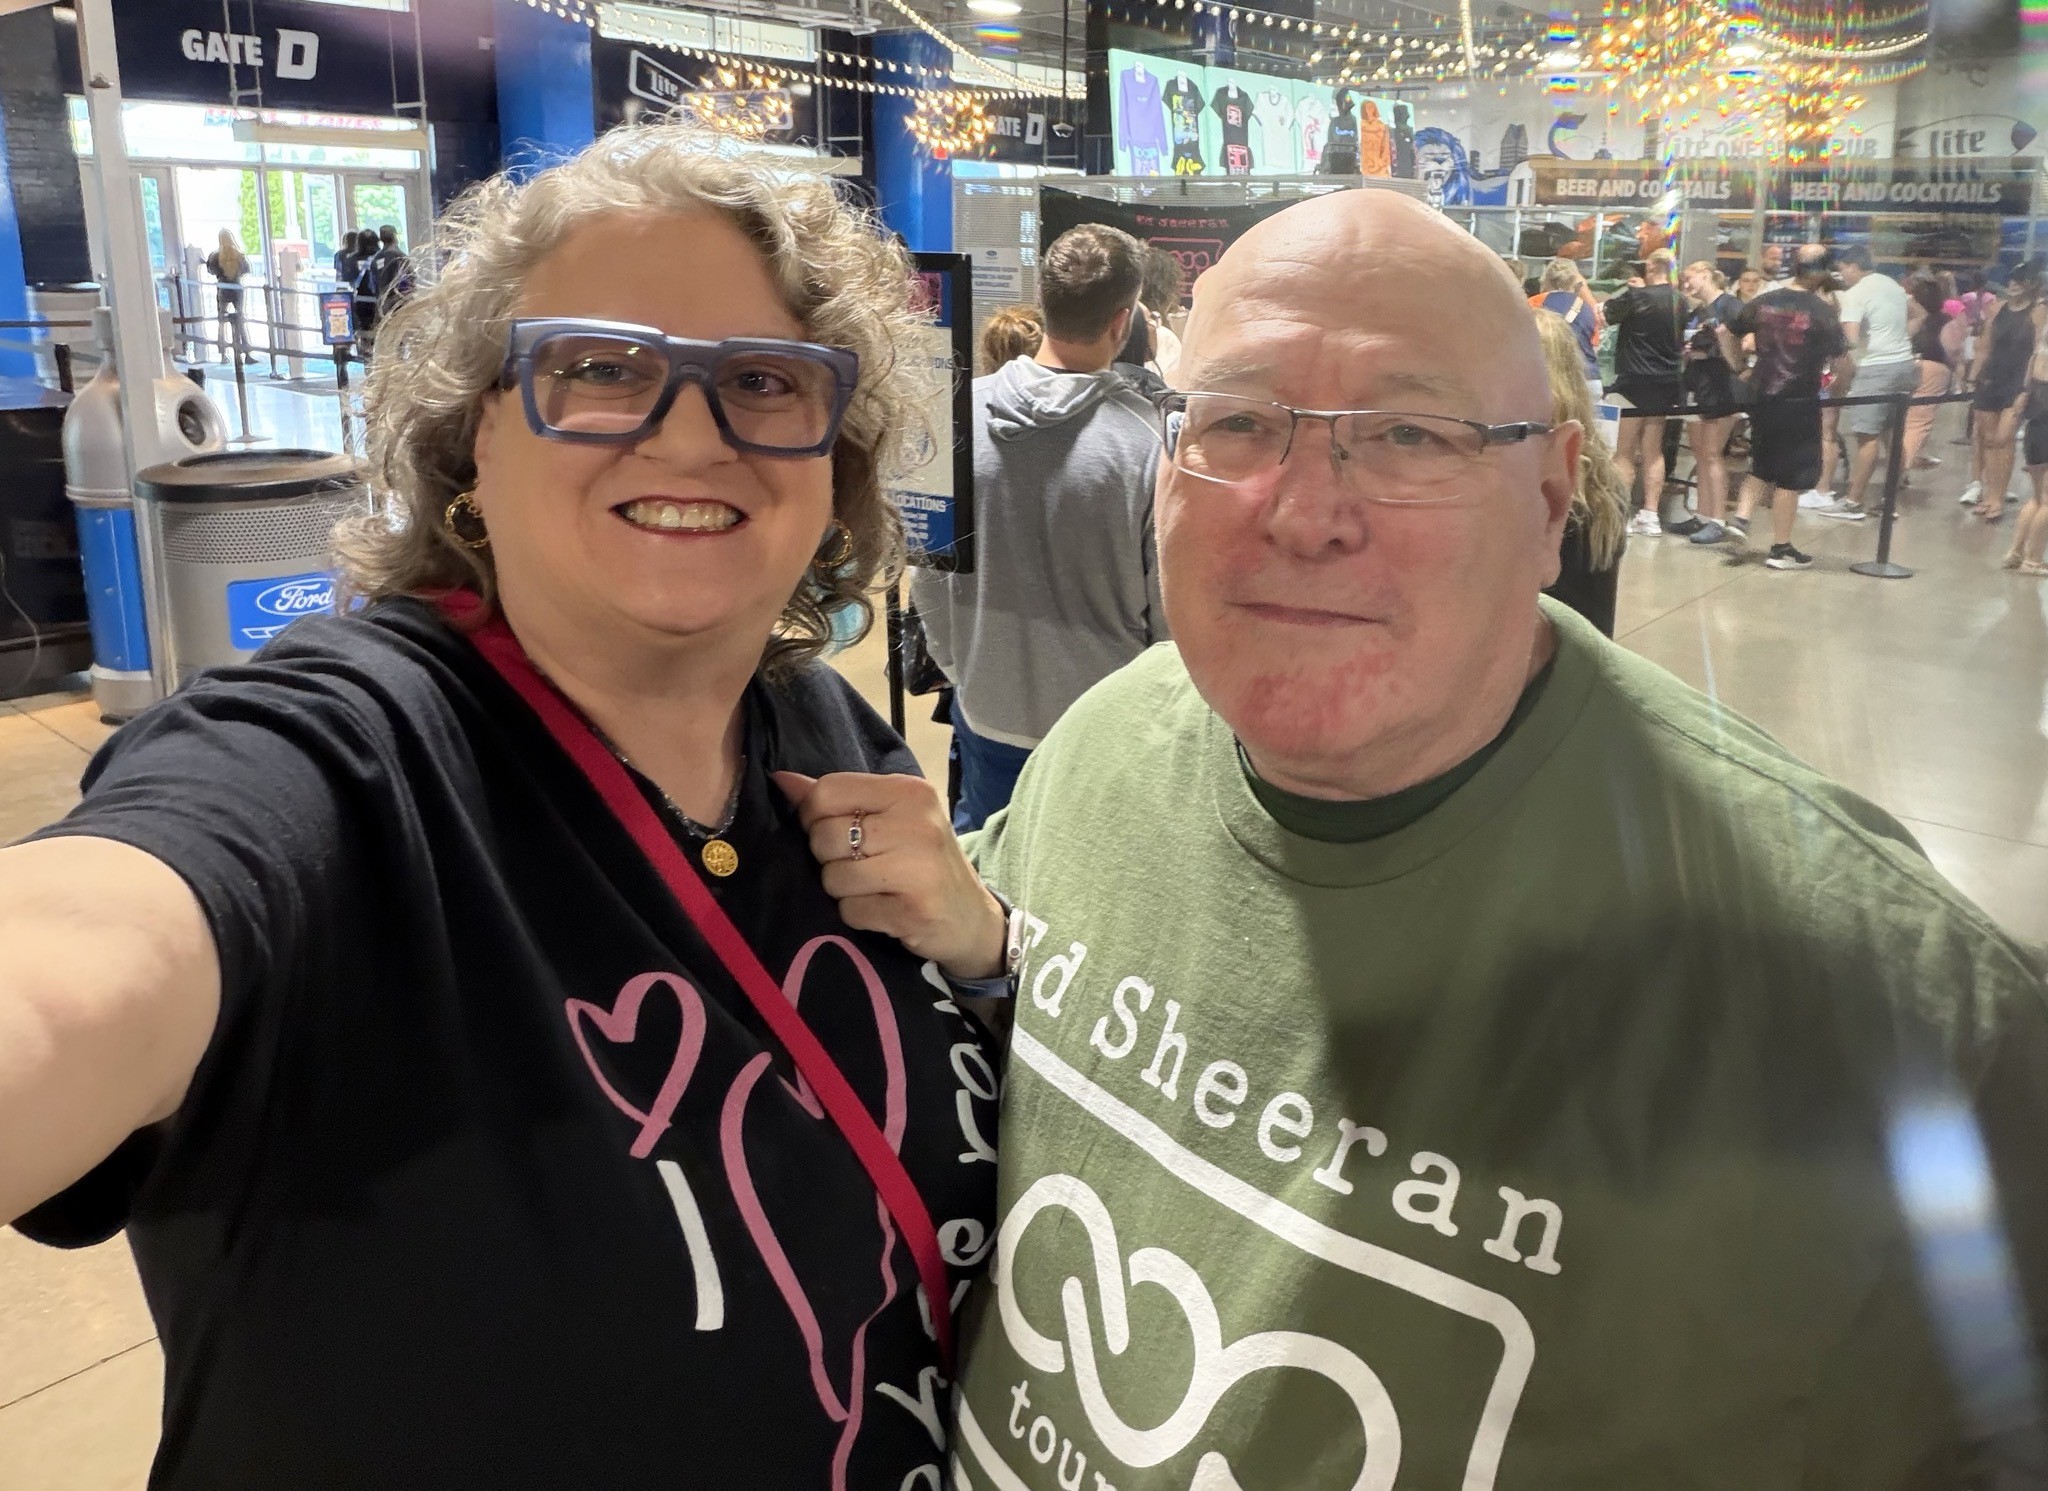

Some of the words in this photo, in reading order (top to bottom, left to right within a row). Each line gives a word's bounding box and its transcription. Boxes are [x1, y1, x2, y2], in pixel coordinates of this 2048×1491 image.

[181, 28, 264, 67] GATE
[275, 28, 320, 81] D
[986, 114, 1022, 138] ATE
[1025, 112, 1044, 145] D
[1556, 178, 1597, 197] BEER
[1597, 179, 1636, 198] AND
[1638, 179, 1731, 200] COTAILS
[1842, 182, 1888, 202] AND
[1889, 182, 2003, 204] COCKTAILS
[275, 583, 334, 612] Ford
[1089, 975, 1563, 1276] Sheeran
